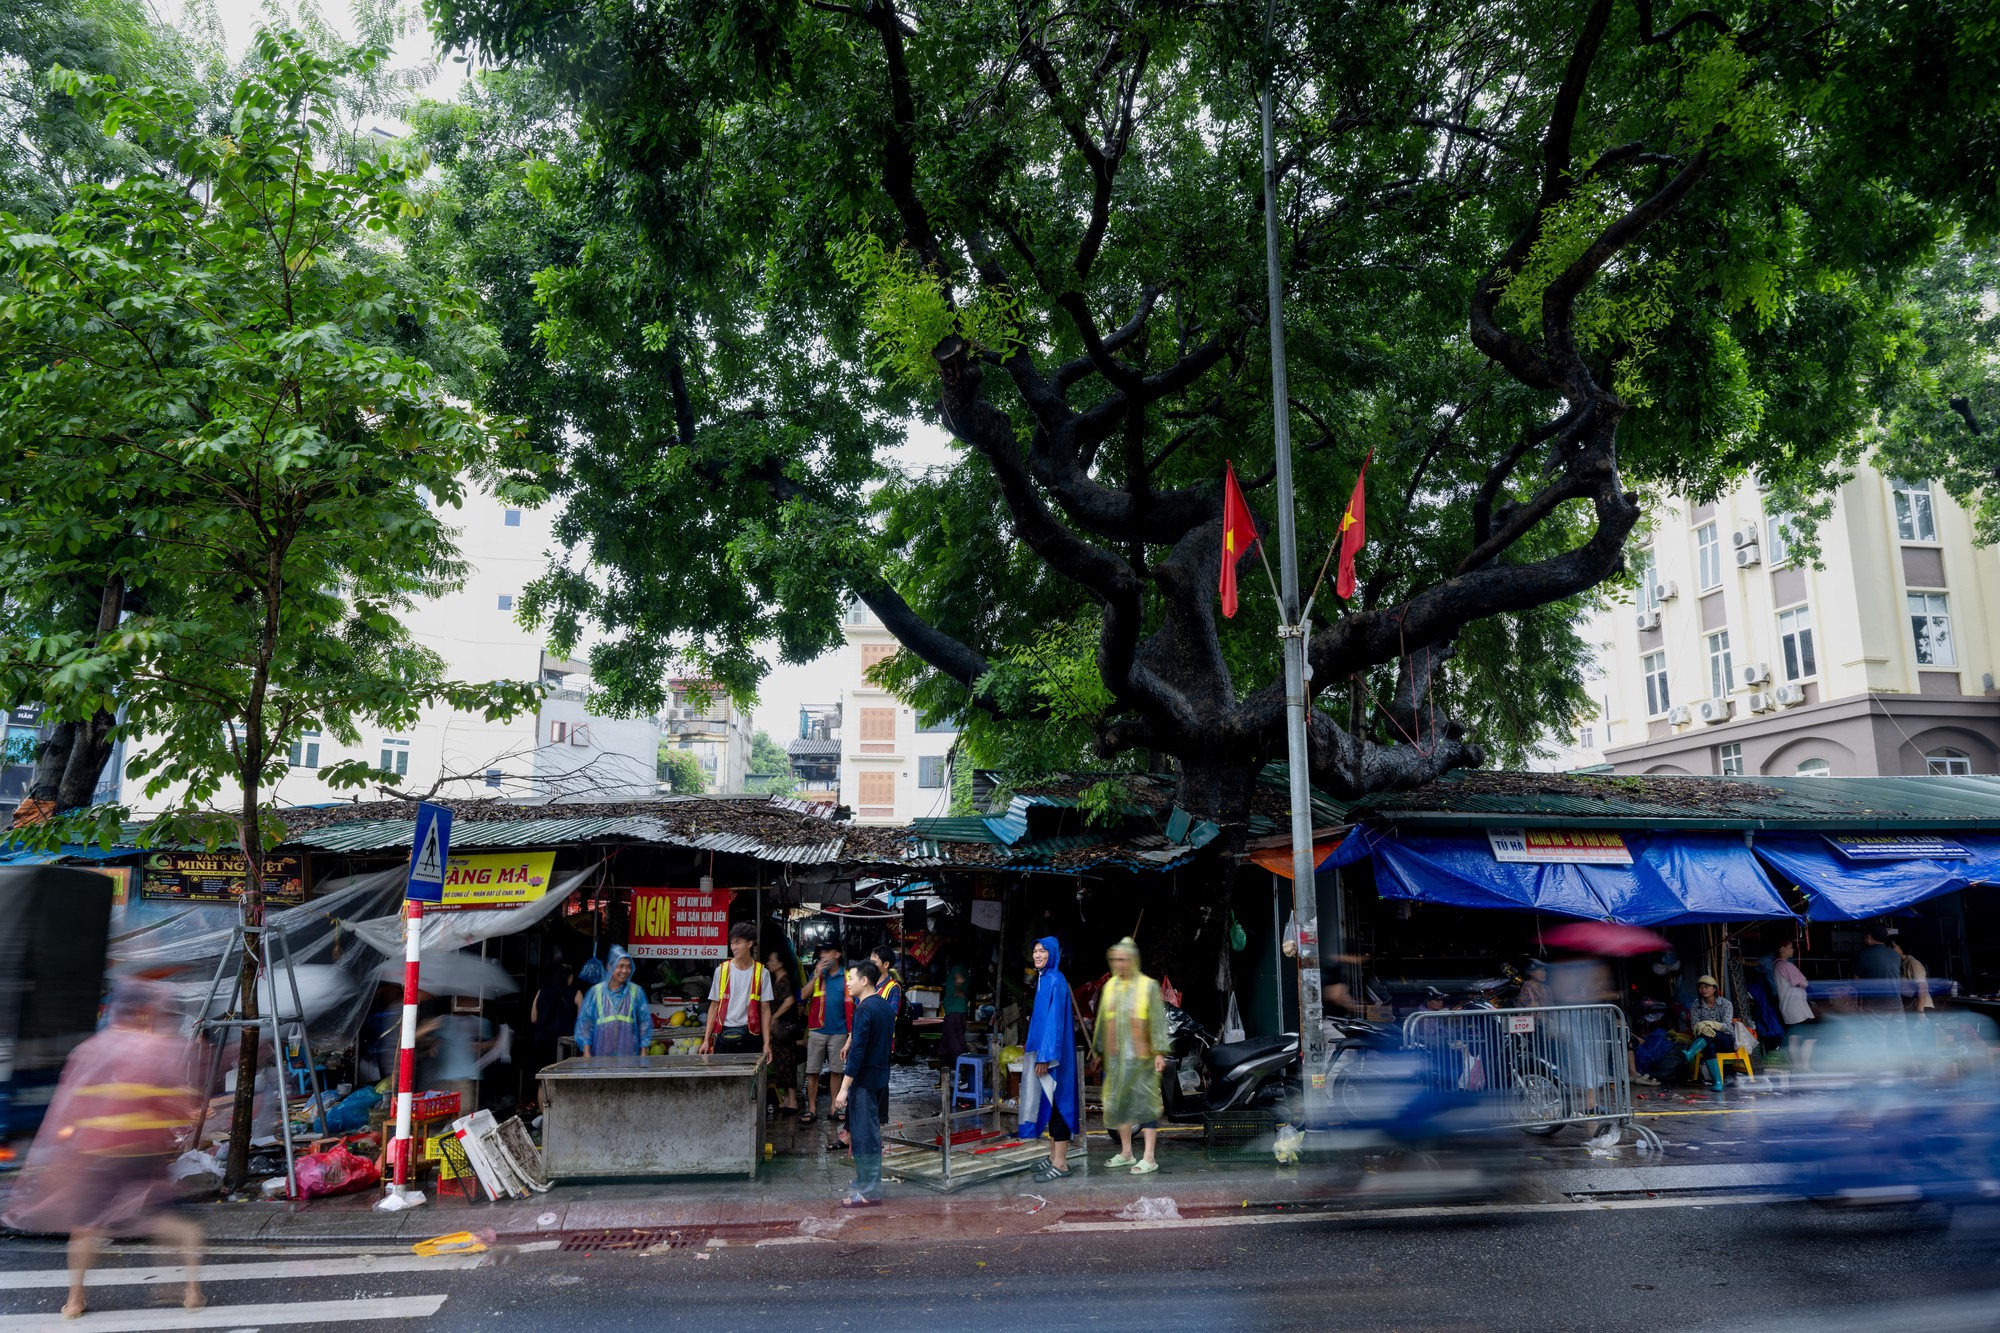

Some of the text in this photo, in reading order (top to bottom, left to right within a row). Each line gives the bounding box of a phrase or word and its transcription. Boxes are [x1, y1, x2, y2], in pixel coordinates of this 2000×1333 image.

[1495, 838, 1508, 851] TÚ
[1510, 840, 1525, 851] HÀ
[1527, 830, 1551, 846] VÀNG
[1550, 830, 1566, 846] MÃ
[196, 852, 227, 862] VÀNG
[177, 861, 217, 870] MINH
[223, 860, 284, 874] NGỆT
[445, 864, 530, 885] ÀNG MÃ
[687, 897, 698, 907] KIM
[700, 895, 712, 907] LIÊN
[635, 895, 671, 937] NEM
[701, 912, 712, 922] KIM
[714, 910, 726, 922] LIÊN
[676, 923, 719, 937] TRUYỀN THỐNG
[657, 948, 679, 956] 0839
[701, 948, 718, 956] 662
